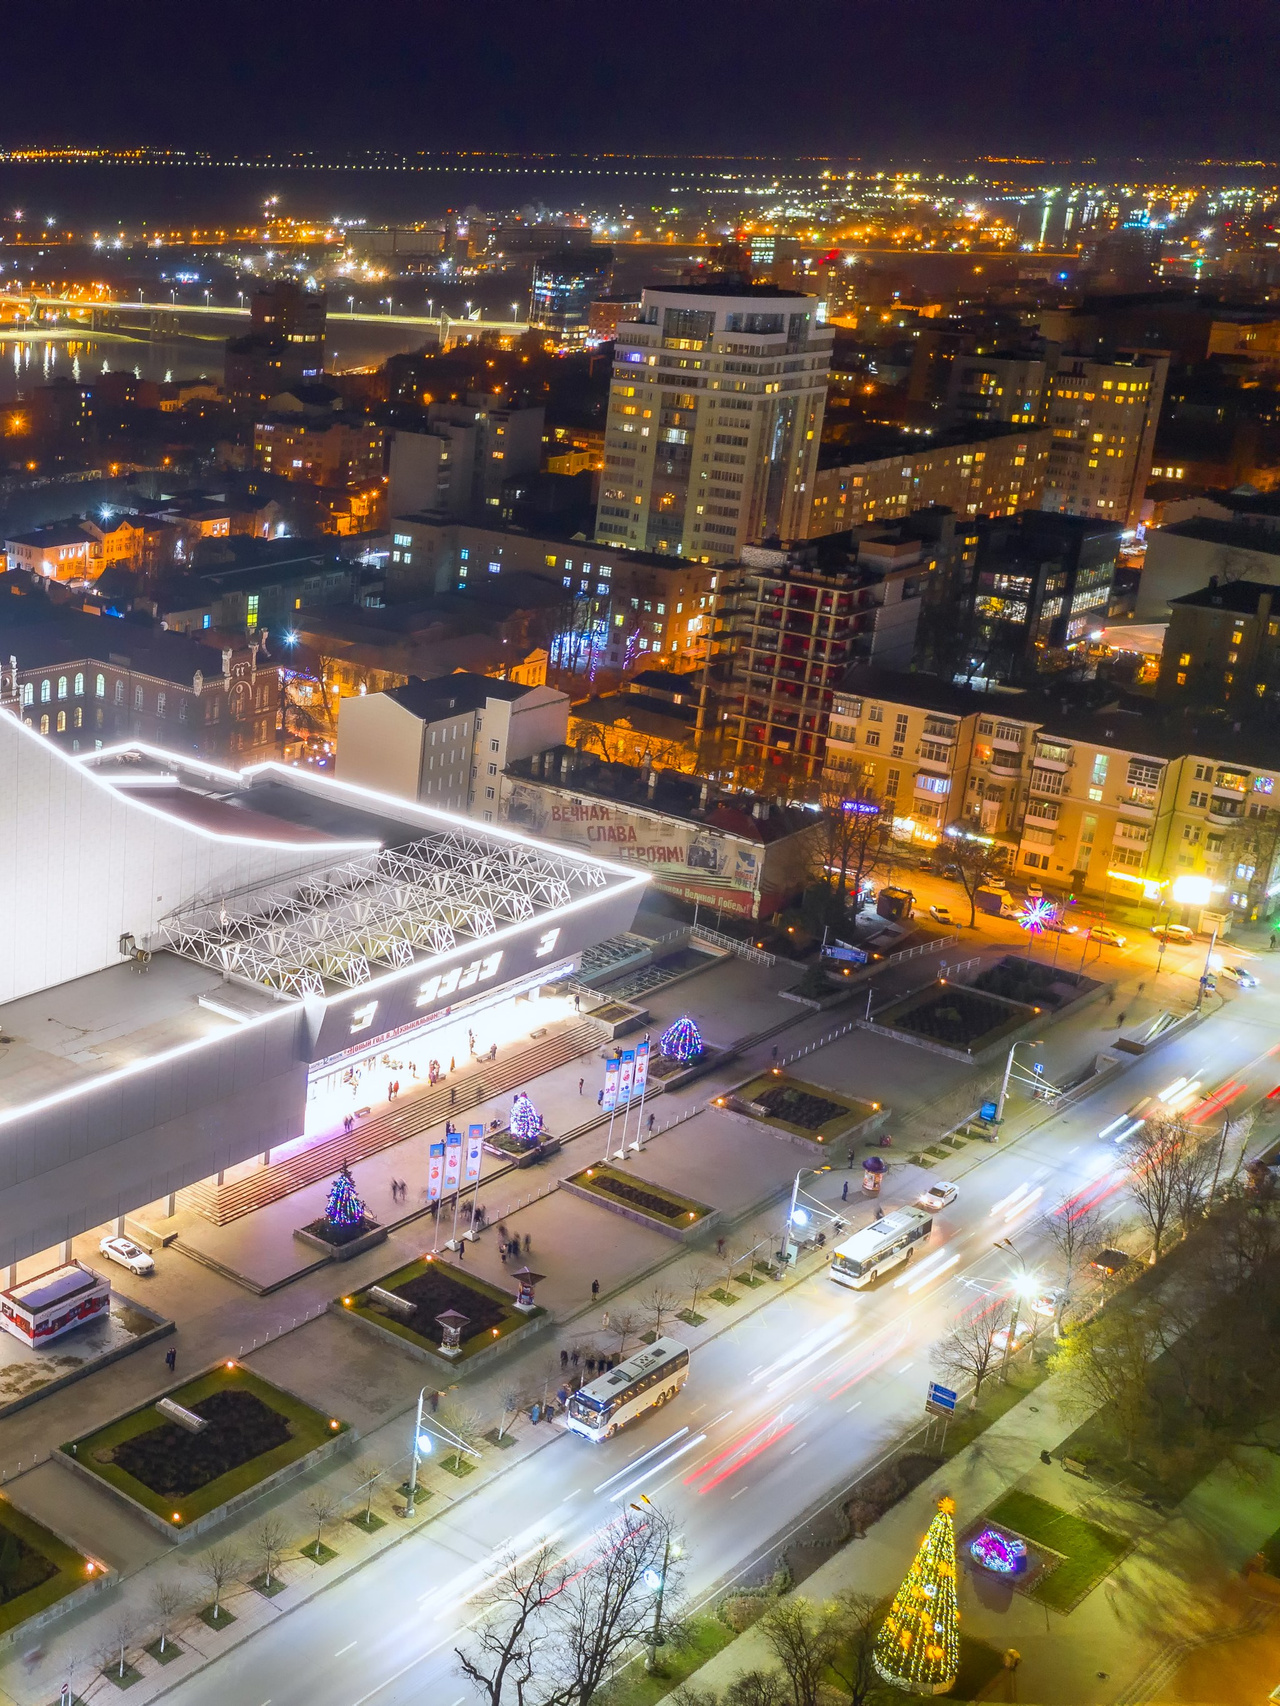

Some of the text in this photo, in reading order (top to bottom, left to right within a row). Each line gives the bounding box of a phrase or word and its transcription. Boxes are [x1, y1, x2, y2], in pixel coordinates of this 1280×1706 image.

[551, 805, 610, 822] ВЕЧНАЯ
[587, 825, 637, 842] СЛАВА
[618, 846, 685, 862] ГЕРОЯМ!
[684, 888, 716, 905] Великой
[717, 896, 750, 914] Победы!
